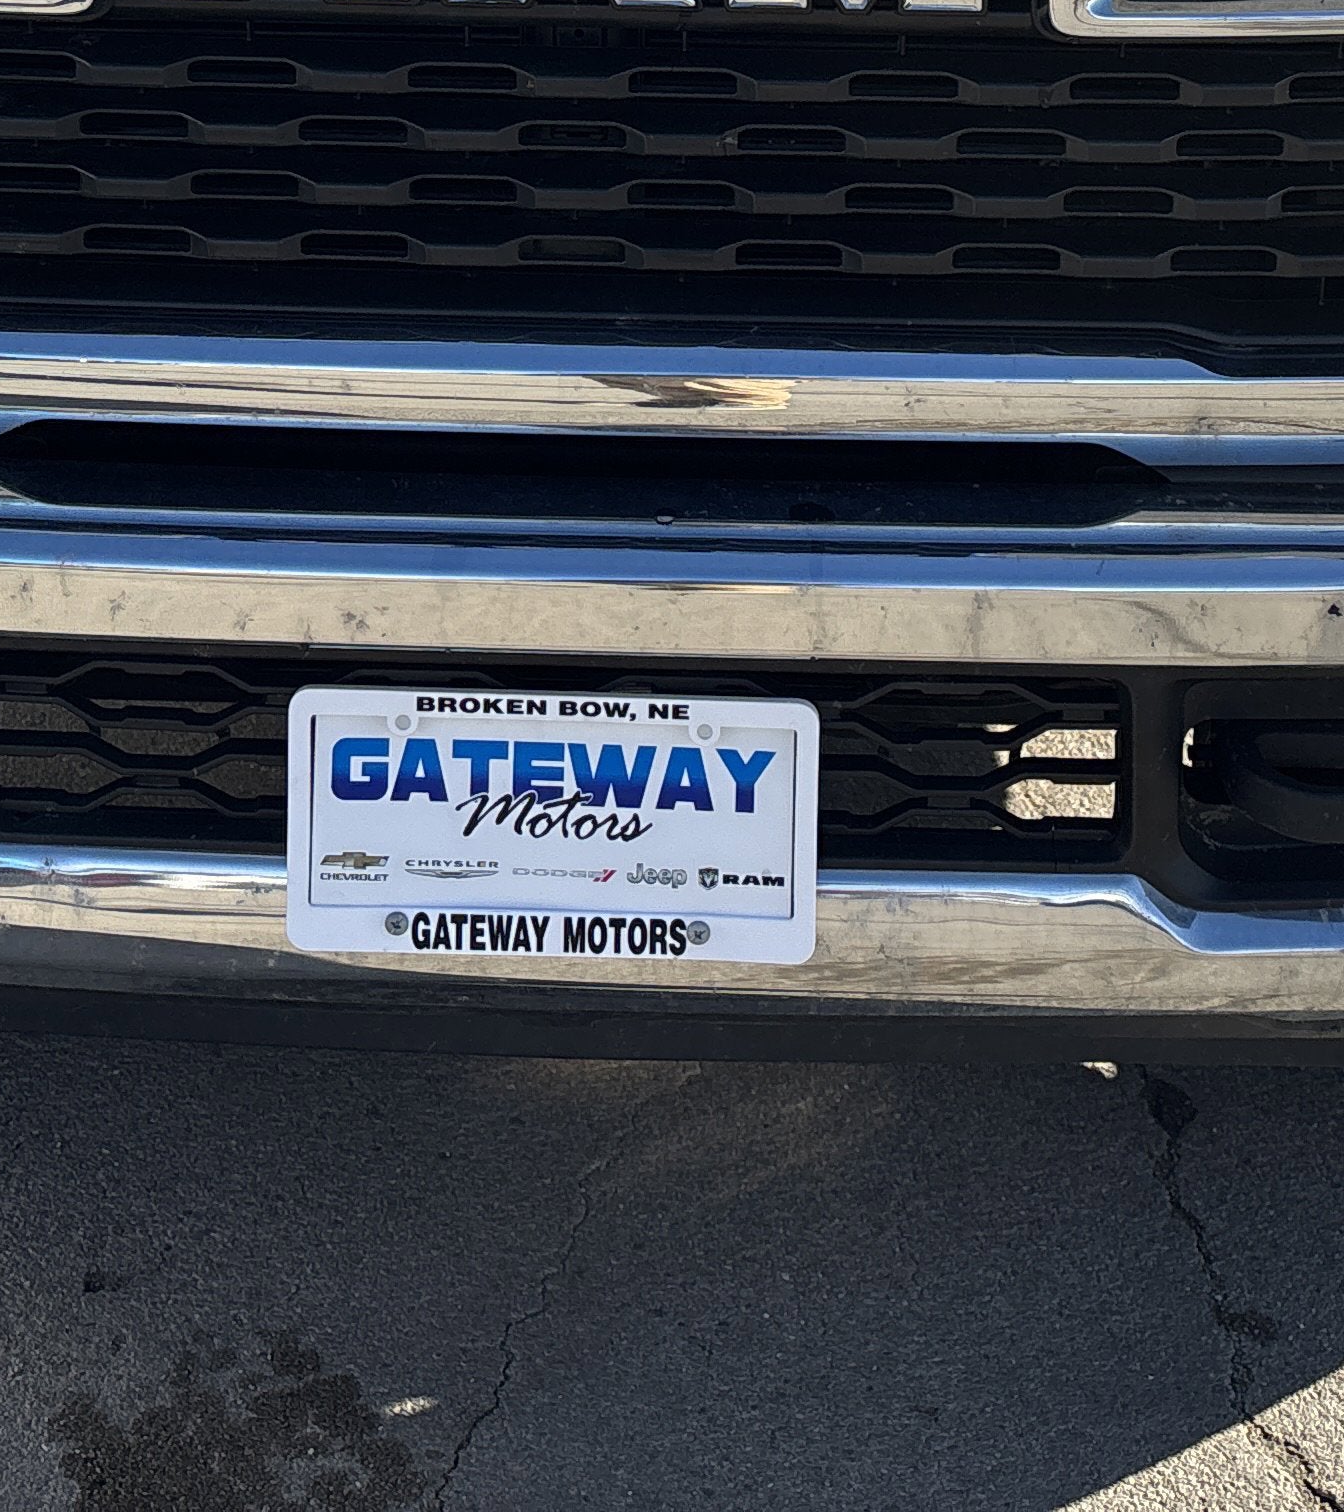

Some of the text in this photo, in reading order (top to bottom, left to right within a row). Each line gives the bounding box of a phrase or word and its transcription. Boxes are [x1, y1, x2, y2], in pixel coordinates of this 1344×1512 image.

[416, 696, 690, 721] BROKEN BOW, NE
[330, 736, 777, 814] GATEWAY
[456, 791, 653, 842] Motors
[405, 859, 499, 869] CHRYSLER
[512, 867, 604, 880] DODGE
[626, 863, 688, 888] Jeep
[320, 872, 389, 882] CHEVROLET
[722, 874, 785, 887] RAM
[411, 911, 687, 956] GATEWAY MOTORS
